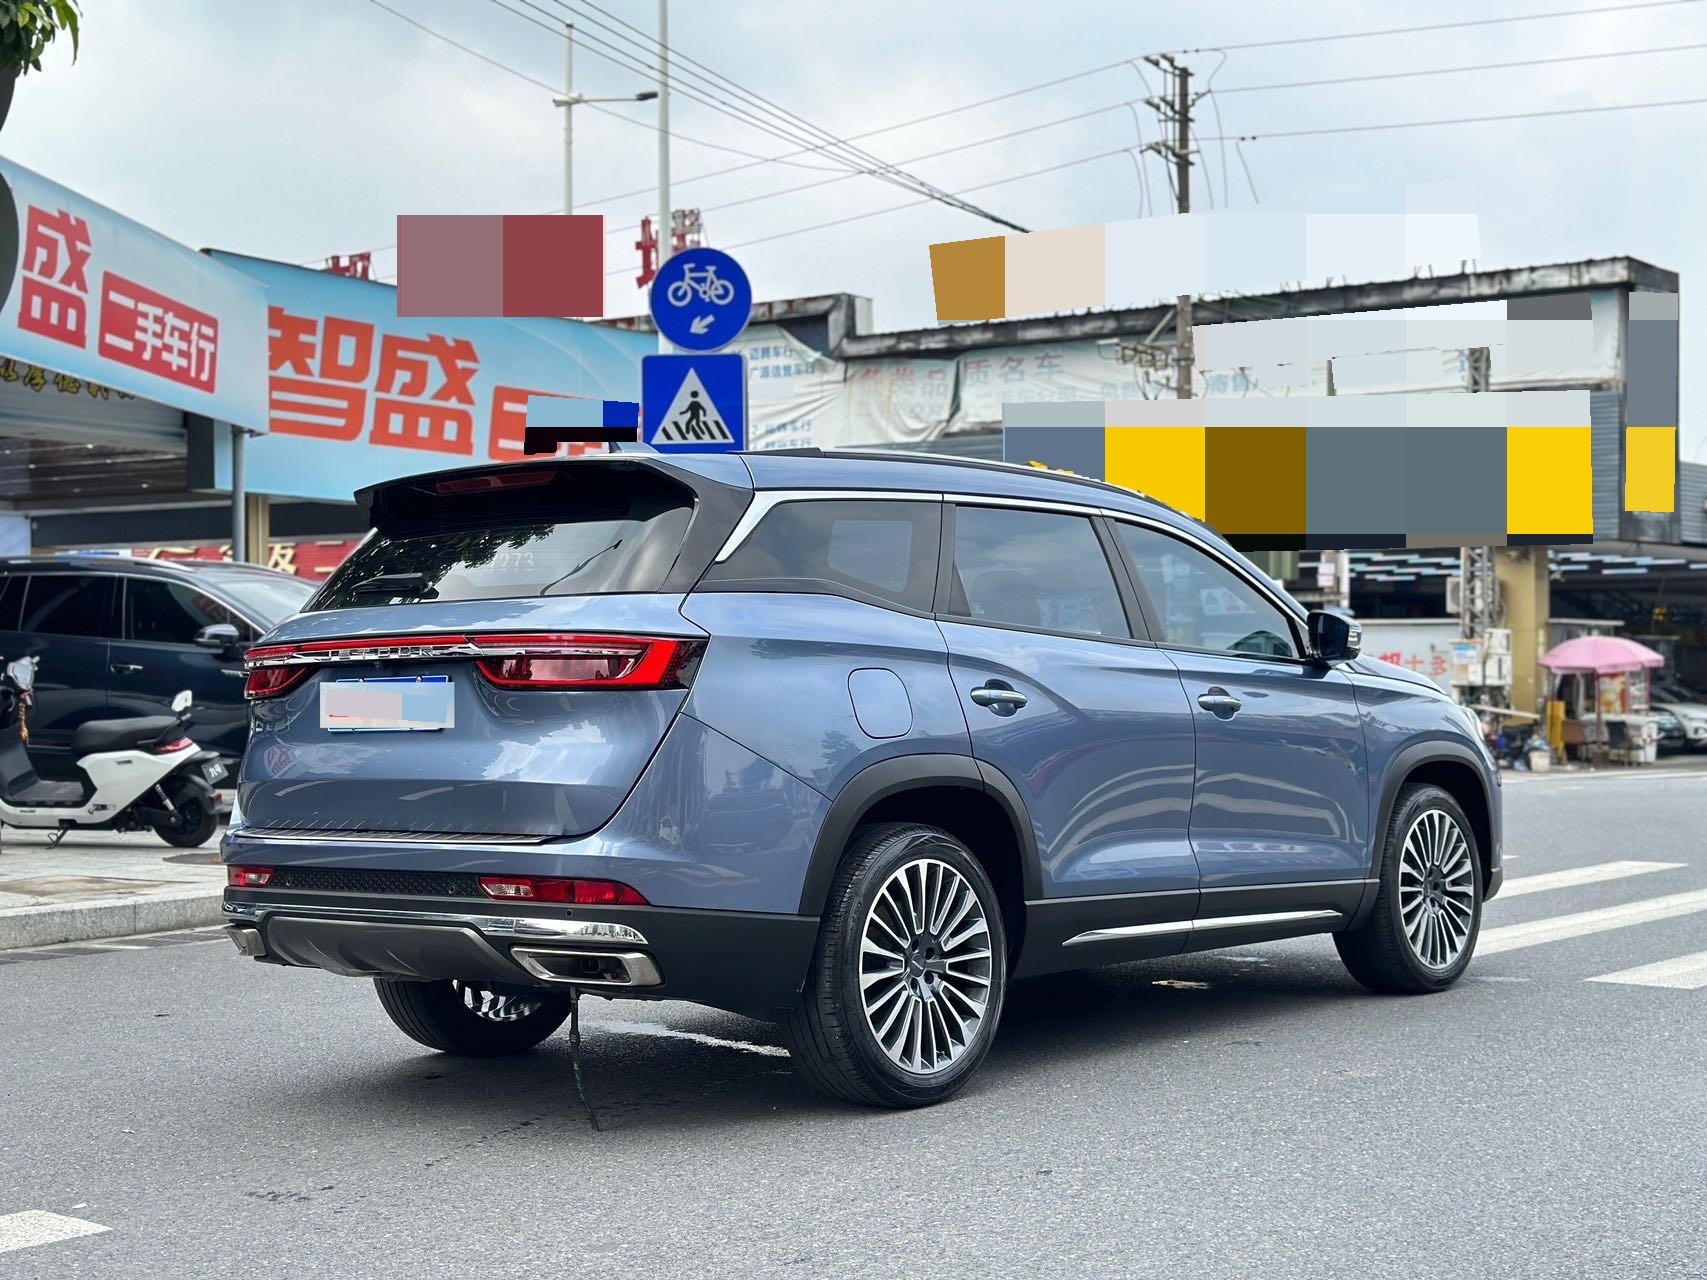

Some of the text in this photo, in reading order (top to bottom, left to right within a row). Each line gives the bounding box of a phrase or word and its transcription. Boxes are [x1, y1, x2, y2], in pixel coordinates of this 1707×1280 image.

[18, 205, 217, 382] 盛 二手车行
[268, 305, 481, 455] 智盛
